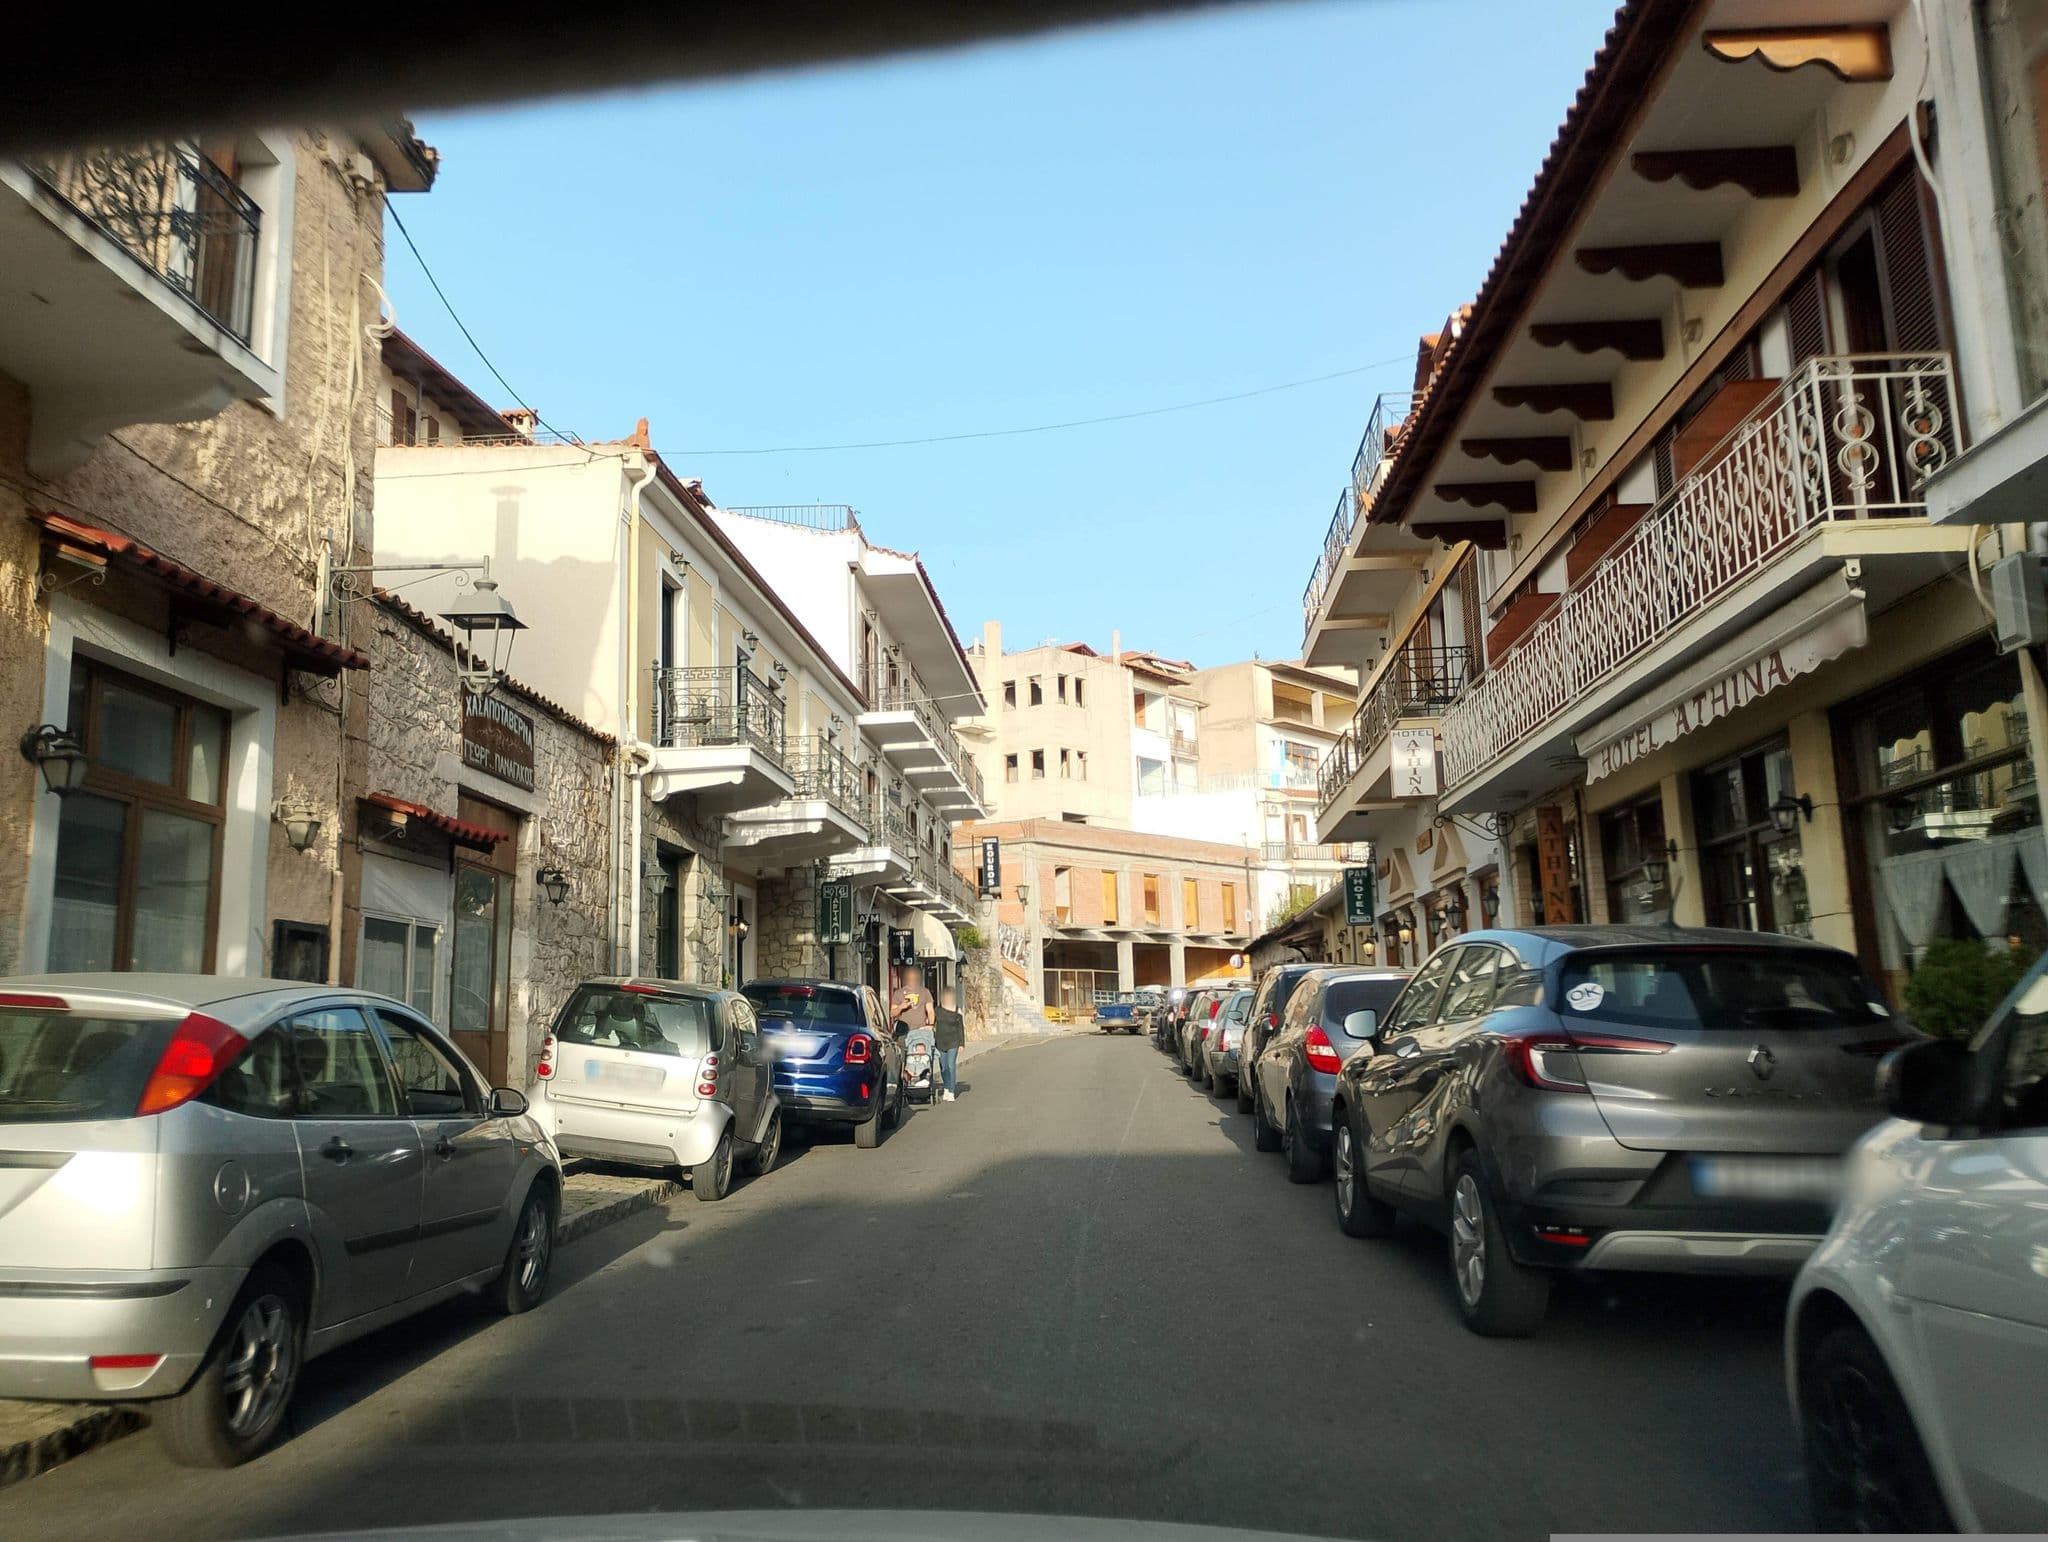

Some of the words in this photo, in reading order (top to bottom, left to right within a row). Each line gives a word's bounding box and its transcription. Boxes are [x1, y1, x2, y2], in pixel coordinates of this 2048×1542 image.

[1392, 730, 1432, 738] HOTEL
[1601, 721, 1659, 776] HOTEL
[1407, 740, 1423, 795] ATHINA
[986, 843, 995, 886] KOUROS
[1543, 821, 1568, 923] ATHINA
[1353, 879, 1365, 915] HOTEL
[1570, 986, 1602, 1001] OK
